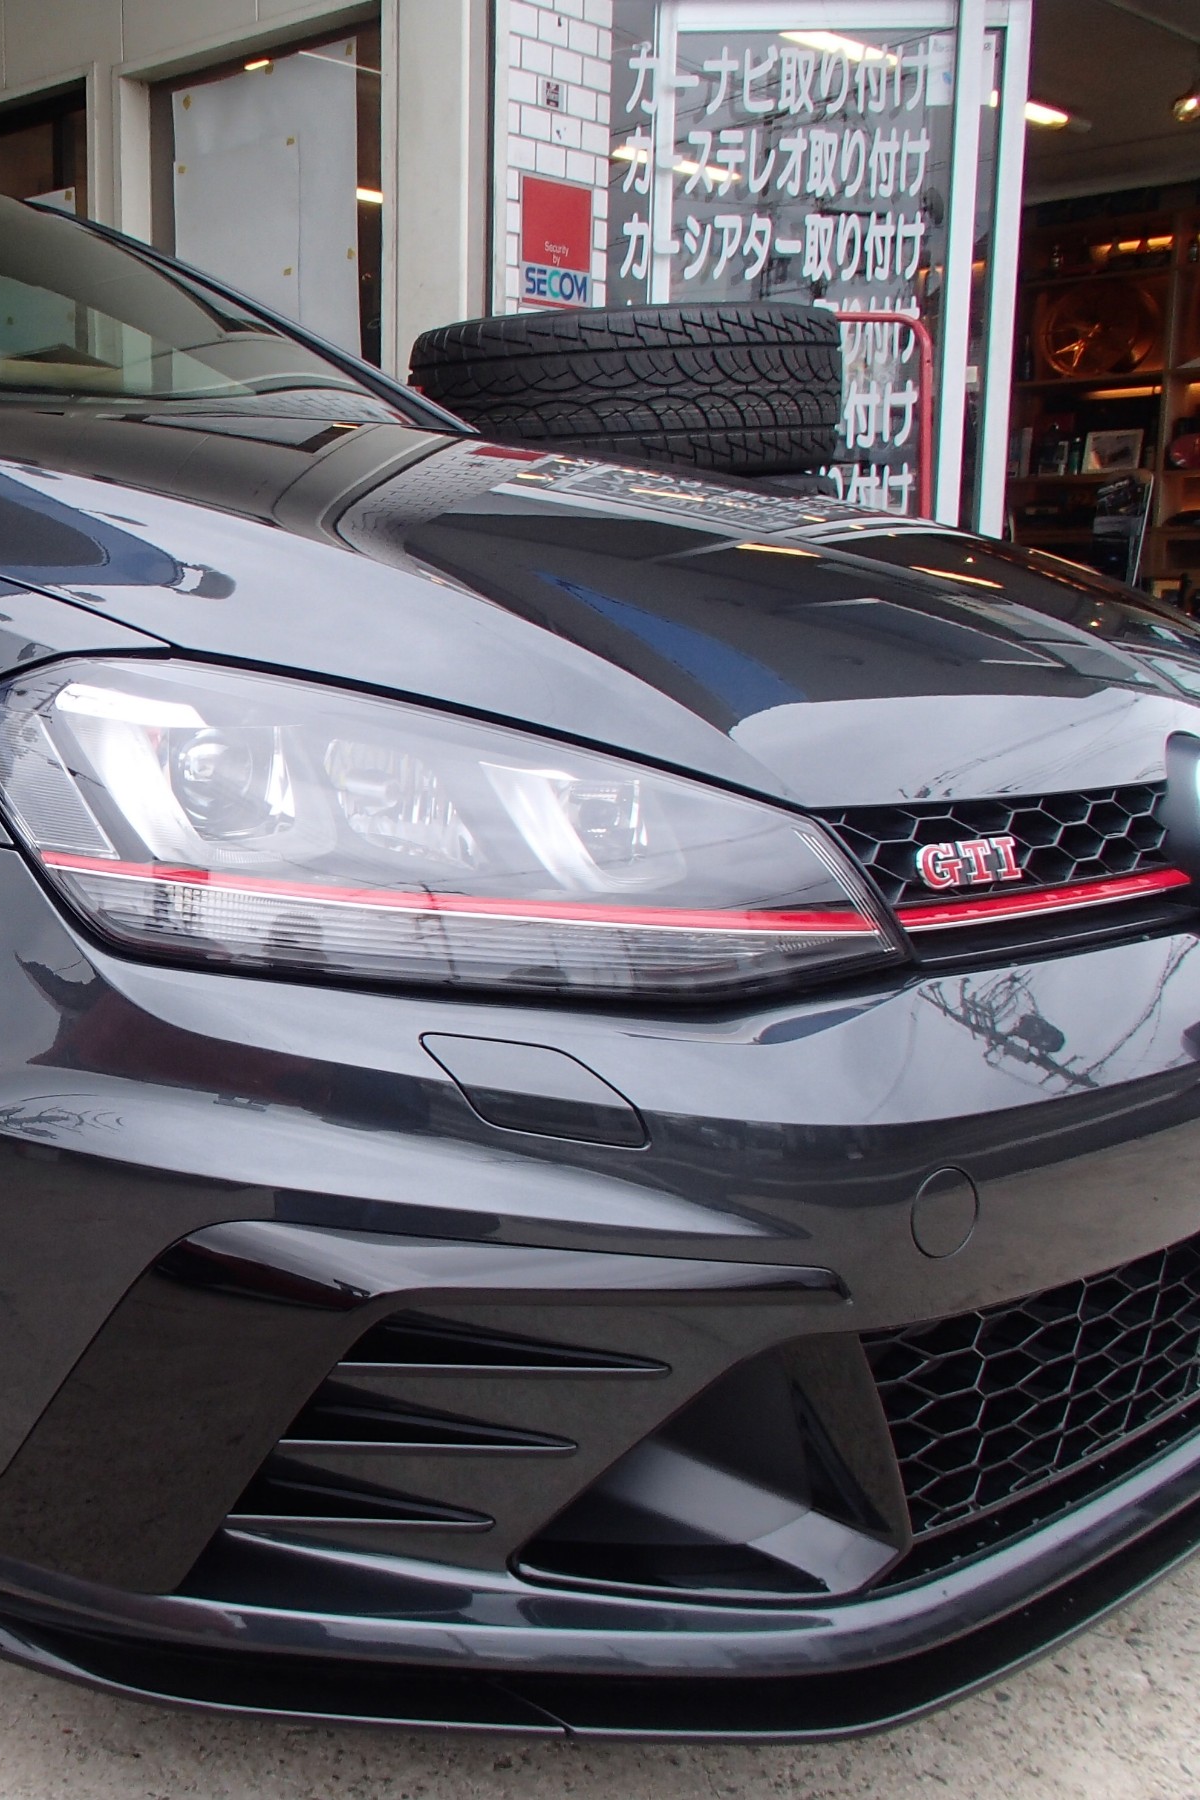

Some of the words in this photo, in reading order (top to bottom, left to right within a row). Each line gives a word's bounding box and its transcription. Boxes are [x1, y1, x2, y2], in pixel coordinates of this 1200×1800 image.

[626, 42, 930, 115] カーナビ取り付け
[622, 126, 930, 198] カーステレオ取り付け
[544, 240, 569, 257] Security
[552, 254, 561, 266] by
[620, 210, 925, 282] カーシアター取り付け
[525, 266, 588, 303] SECOM
[916, 836, 1022, 890] GTI
